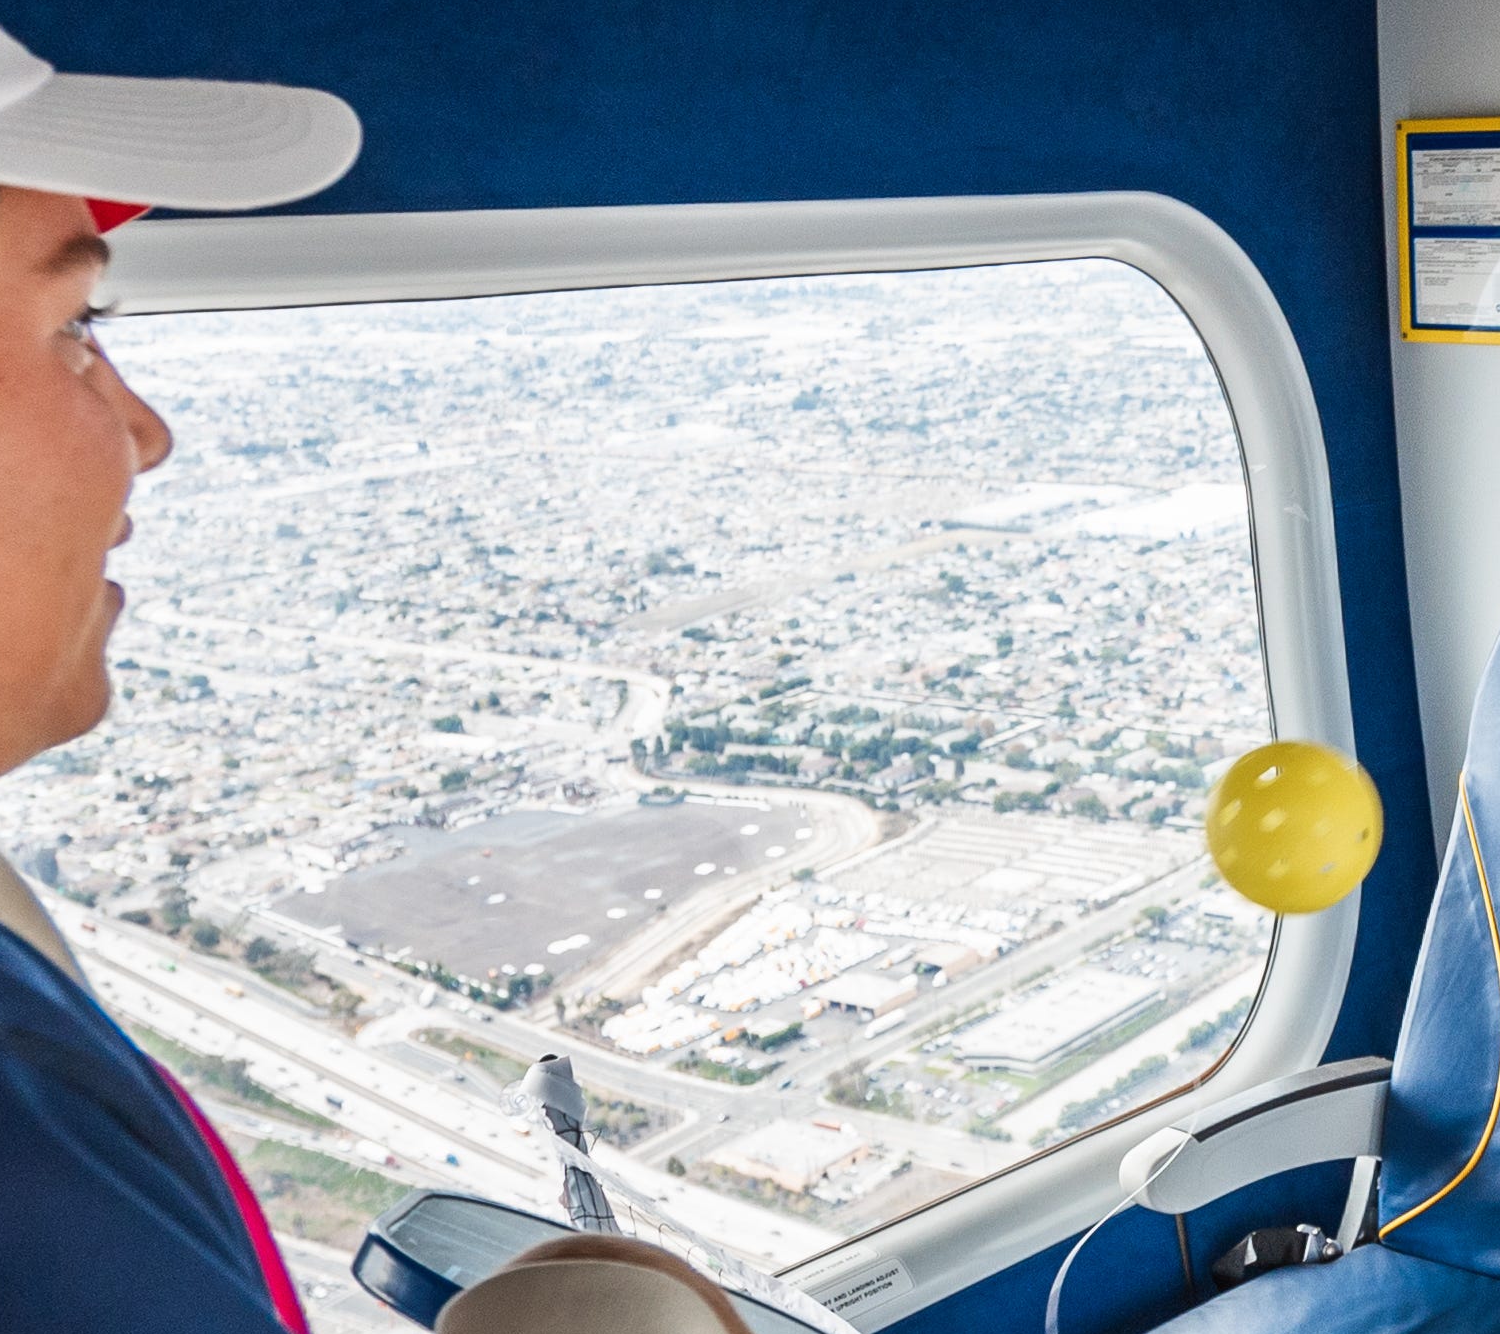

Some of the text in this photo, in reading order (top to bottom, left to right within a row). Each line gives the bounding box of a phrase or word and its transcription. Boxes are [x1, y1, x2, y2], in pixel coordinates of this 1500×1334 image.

[833, 1293, 848, 1303] AND
[847, 1279, 876, 1299] LANDING
[876, 1268, 900, 1283] ADJUST
[837, 1281, 893, 1312] UPRIGHT POSITION
